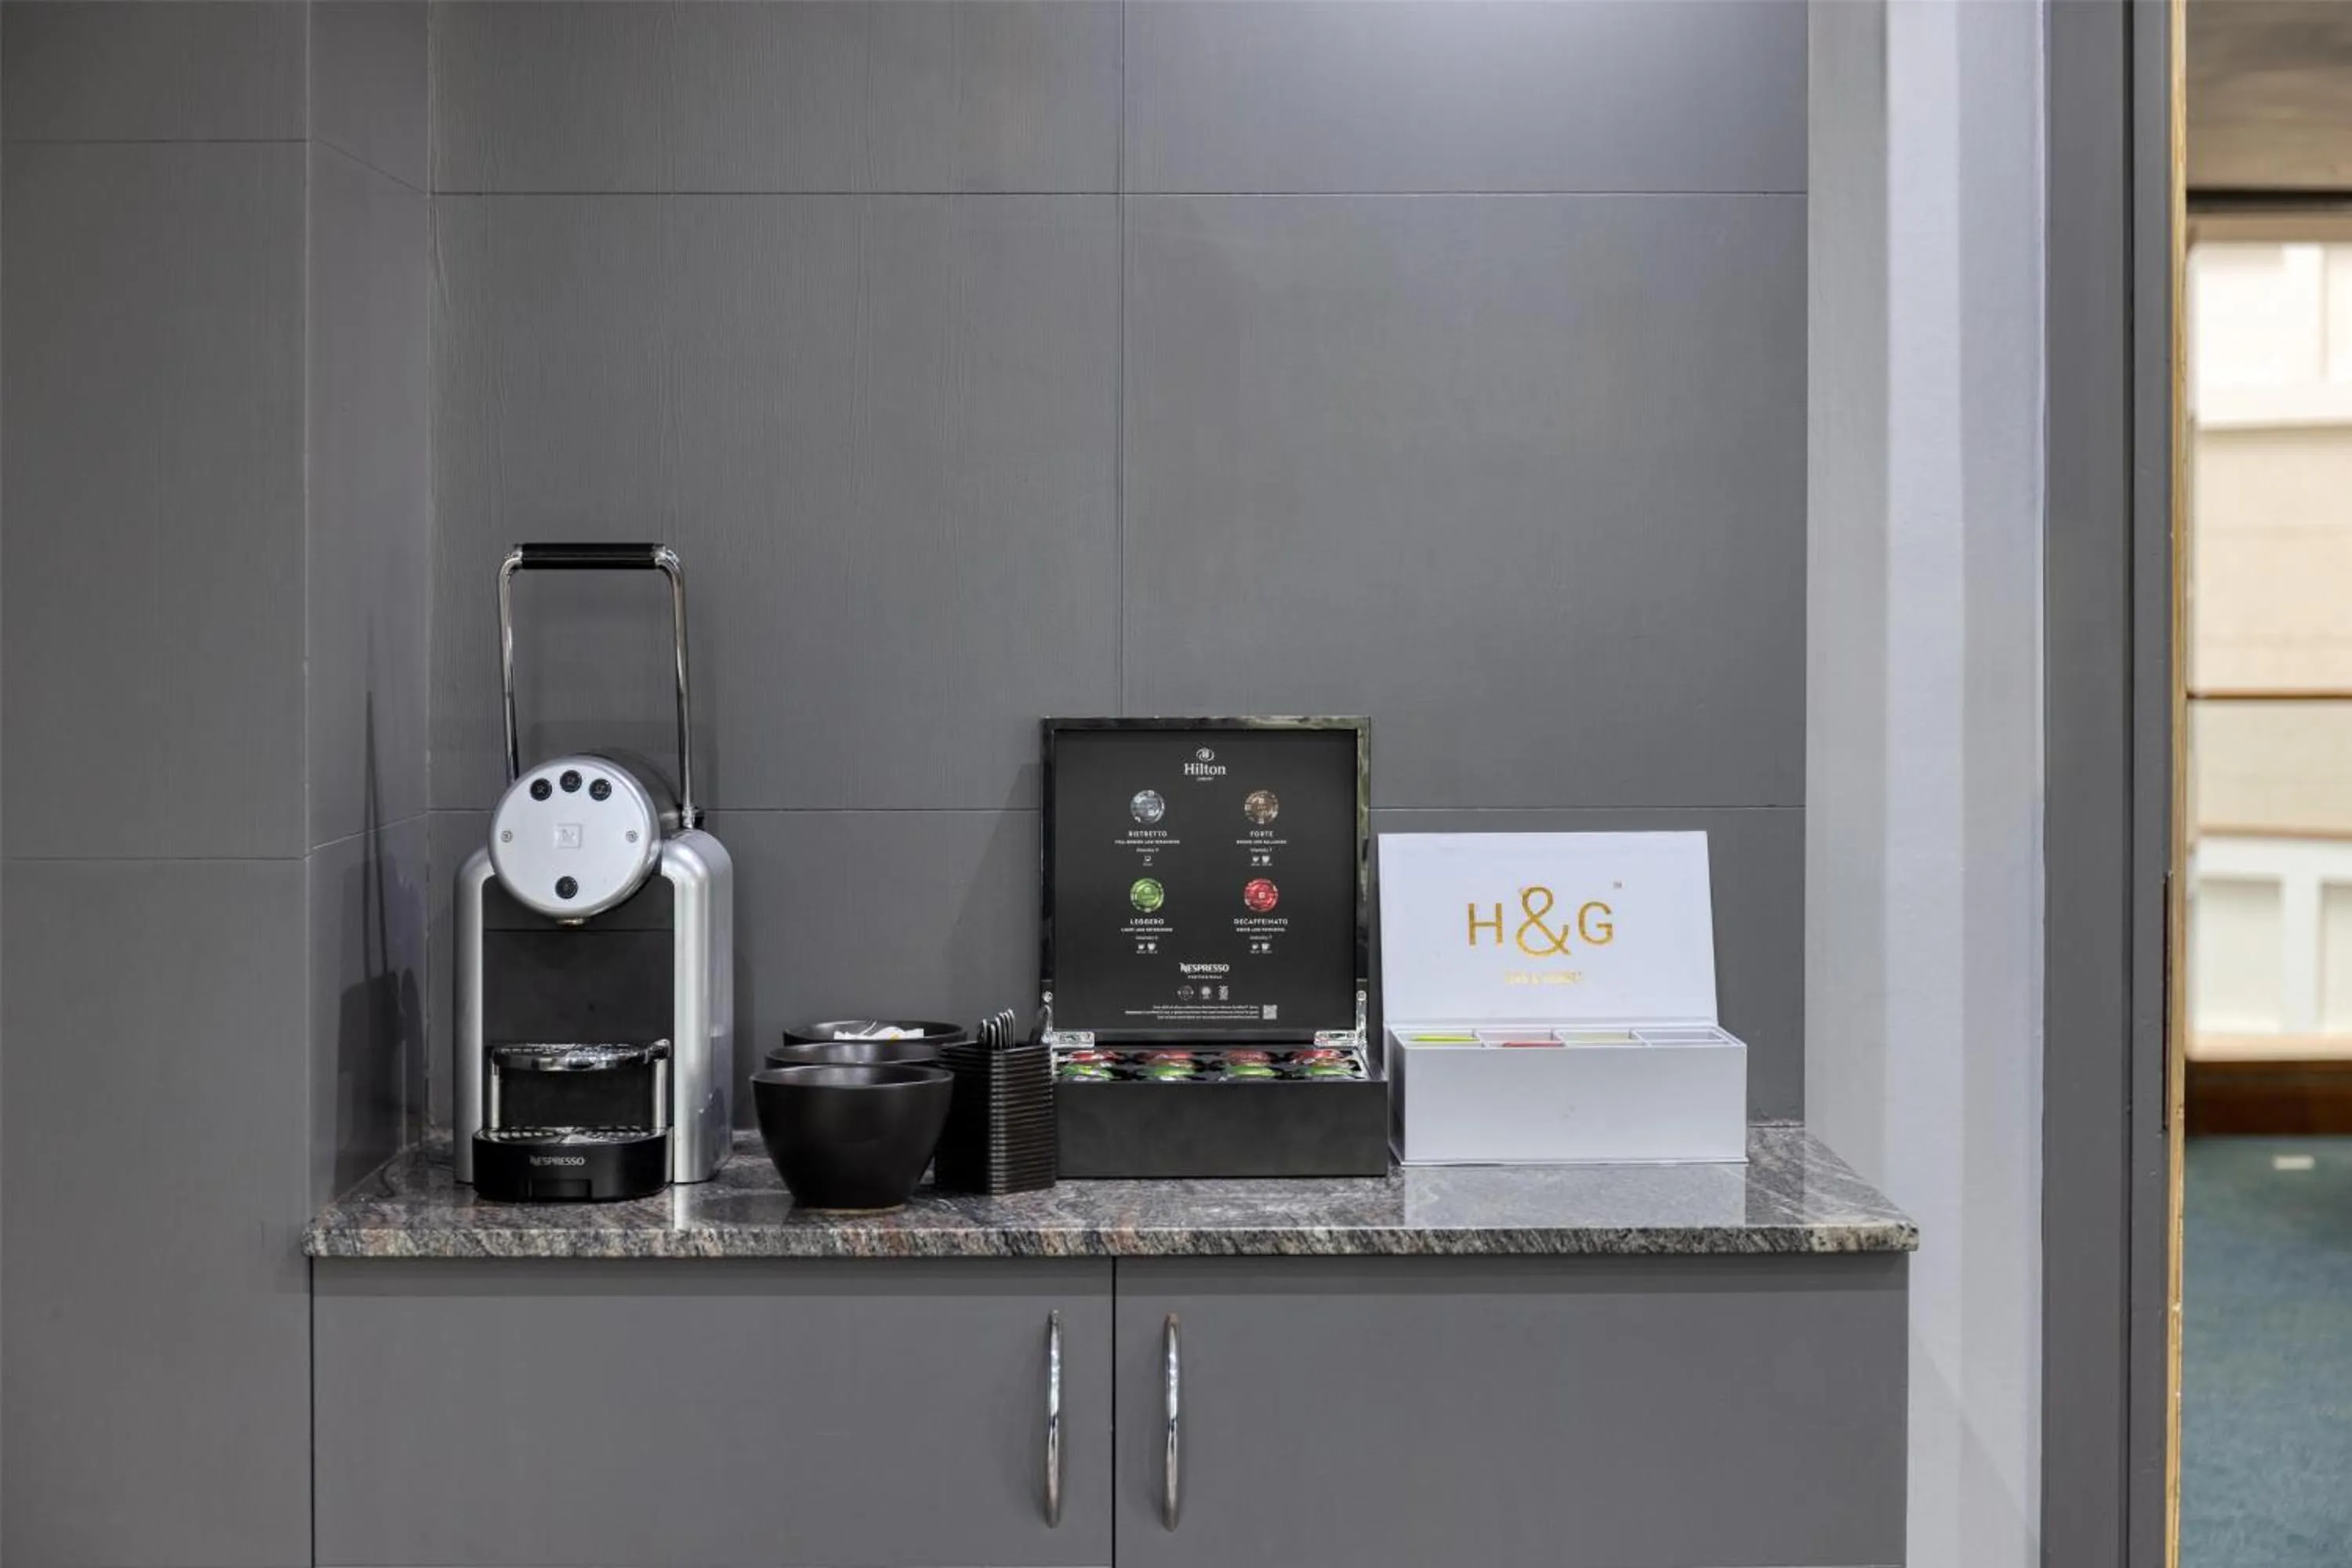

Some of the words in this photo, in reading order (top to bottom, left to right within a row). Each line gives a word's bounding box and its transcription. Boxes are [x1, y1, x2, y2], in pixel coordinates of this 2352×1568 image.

[1184, 763, 1226, 775] Hilton
[1179, 962, 1230, 973] NESPRESSO
[528, 1154, 585, 1167] NESPRESSO
